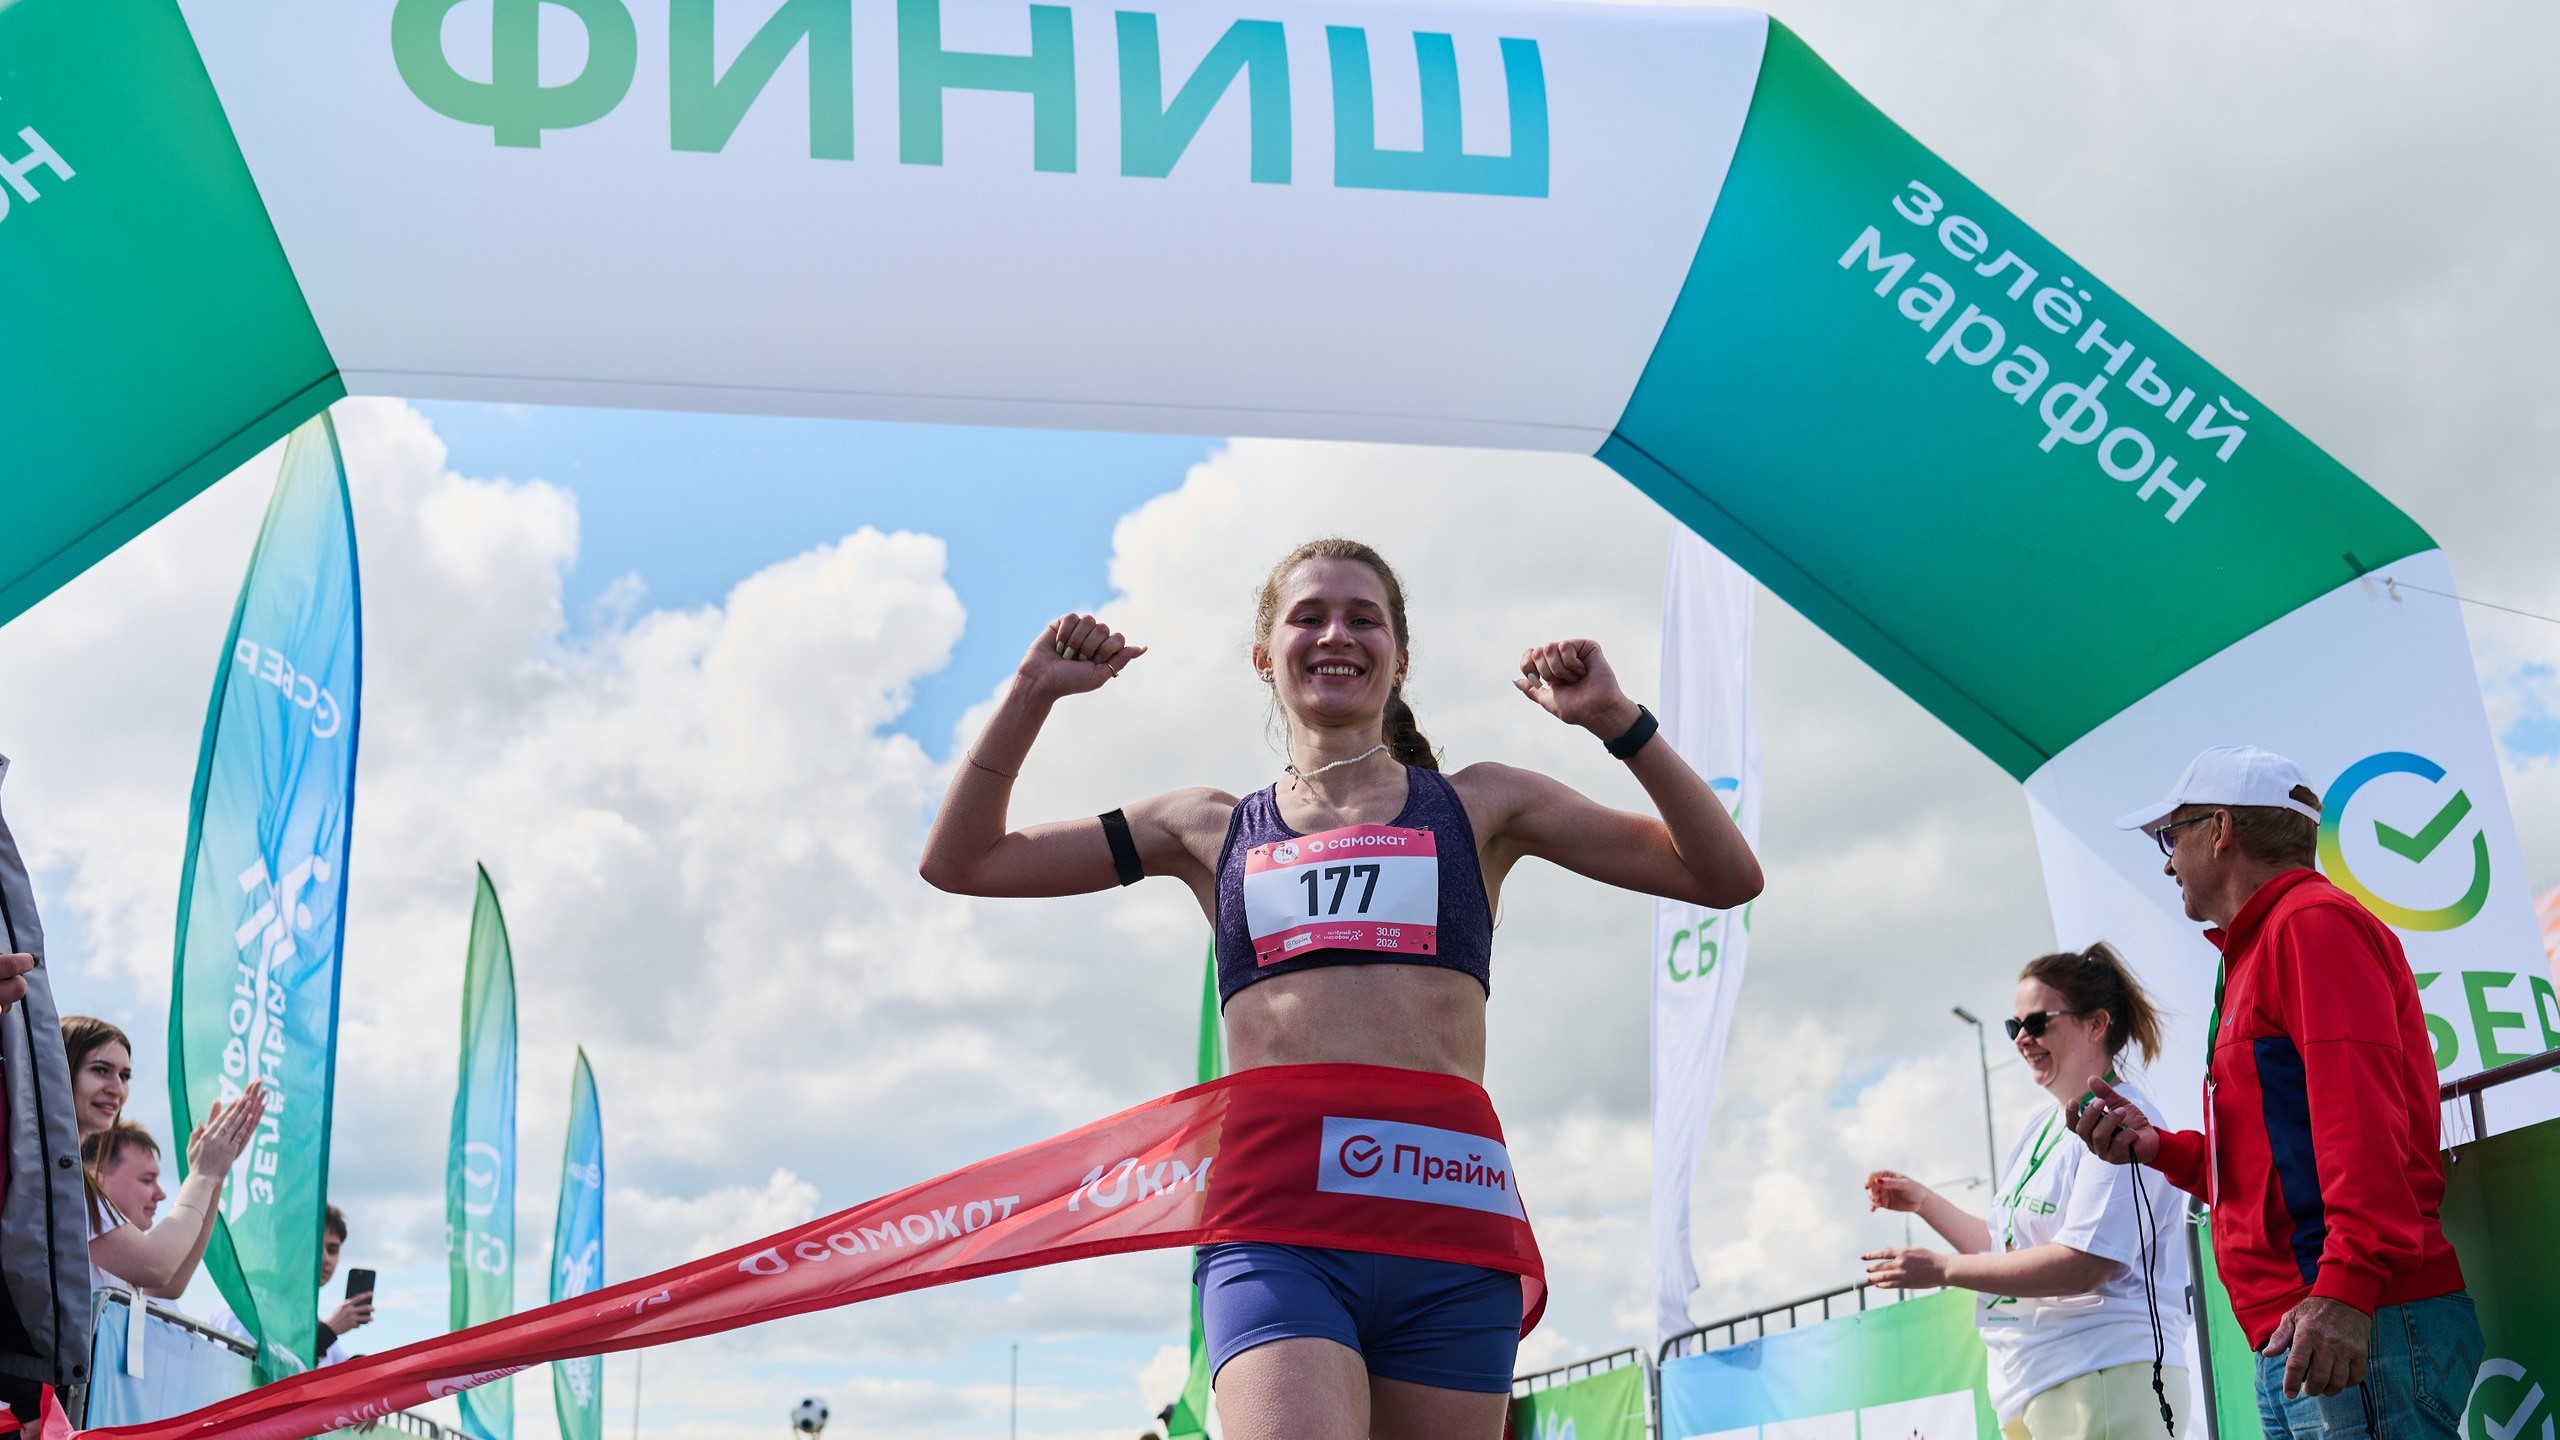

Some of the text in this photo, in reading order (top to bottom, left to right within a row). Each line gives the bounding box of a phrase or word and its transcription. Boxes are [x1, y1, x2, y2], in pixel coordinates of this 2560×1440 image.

[391, 0, 1549, 198] ФИНИШ
[1892, 180, 2250, 463] зелёный
[1837, 224, 2207, 524] марафон
[1328, 835, 1408, 850] самокат
[1300, 863, 1381, 917] 177
[1376, 927, 1401, 938] 30.05
[1376, 938, 1398, 948] 2026
[2413, 970, 2560, 1073] БЕР
[1392, 1144, 1506, 1191] Прайм
